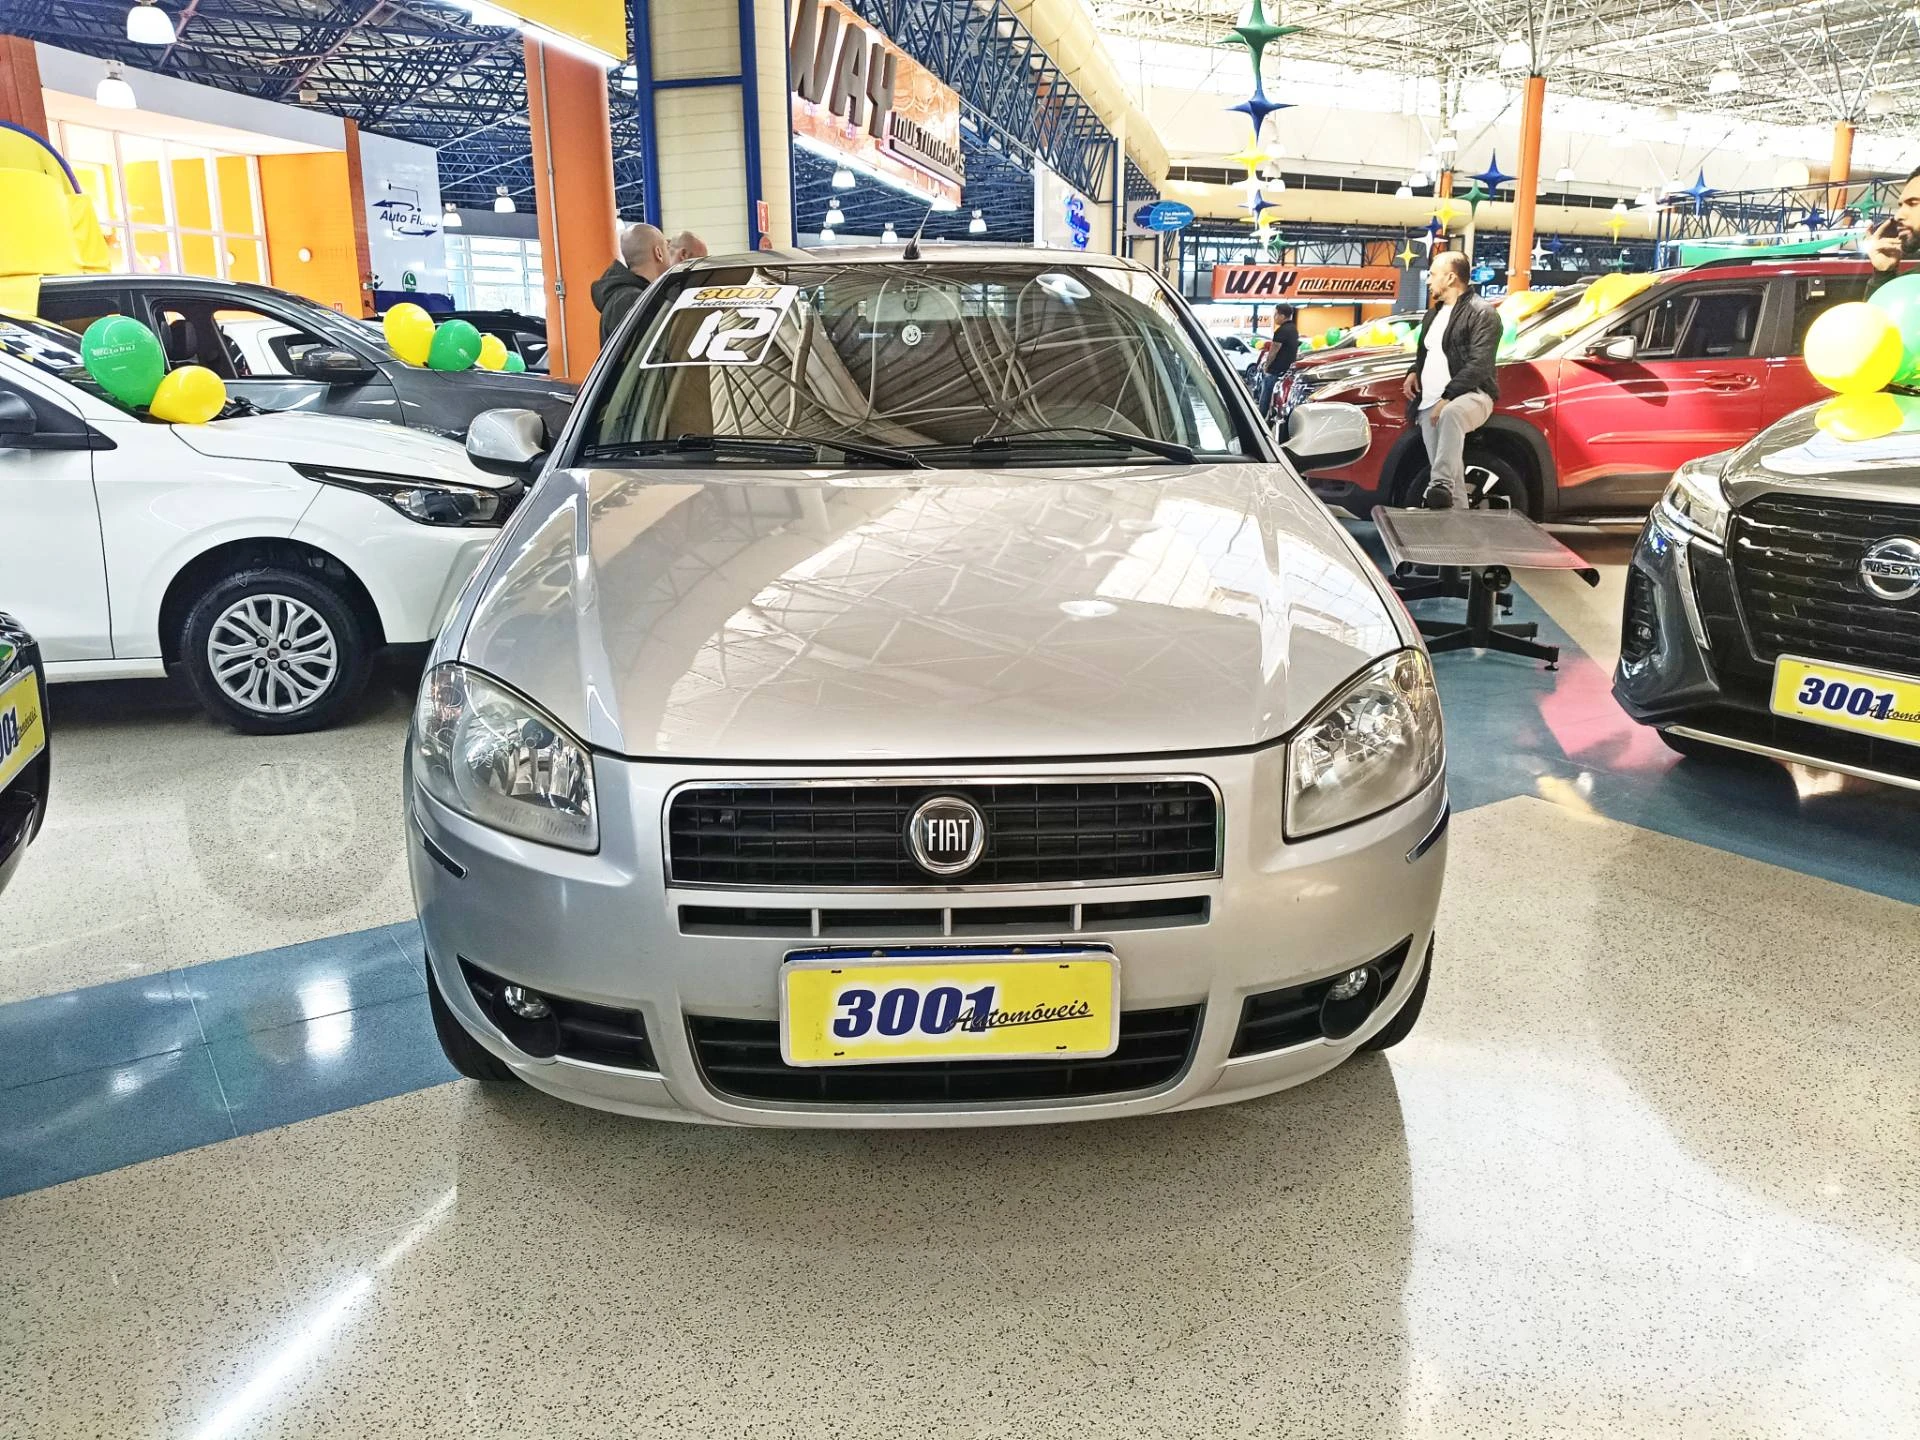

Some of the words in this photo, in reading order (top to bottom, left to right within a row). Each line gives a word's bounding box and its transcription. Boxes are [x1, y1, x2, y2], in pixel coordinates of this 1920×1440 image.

[790, 0, 897, 140] WAY
[890, 112, 966, 177] MULTIMARCAS
[380, 209, 407, 223] Auto
[410, 214, 438, 228] Flu
[694, 287, 782, 300] 3001
[1225, 270, 1298, 295] WAY
[1299, 278, 1395, 292] MULTIMARCAS
[687, 308, 778, 361] 12
[1865, 560, 1920, 577] NISSAN
[1798, 677, 1894, 720] 3001
[1865, 703, 1920, 721] Atomó
[0, 706, 18, 763] 01
[928, 818, 970, 852] FIAT
[833, 986, 995, 1038] 3001
[945, 999, 1091, 1033] Automóveis
